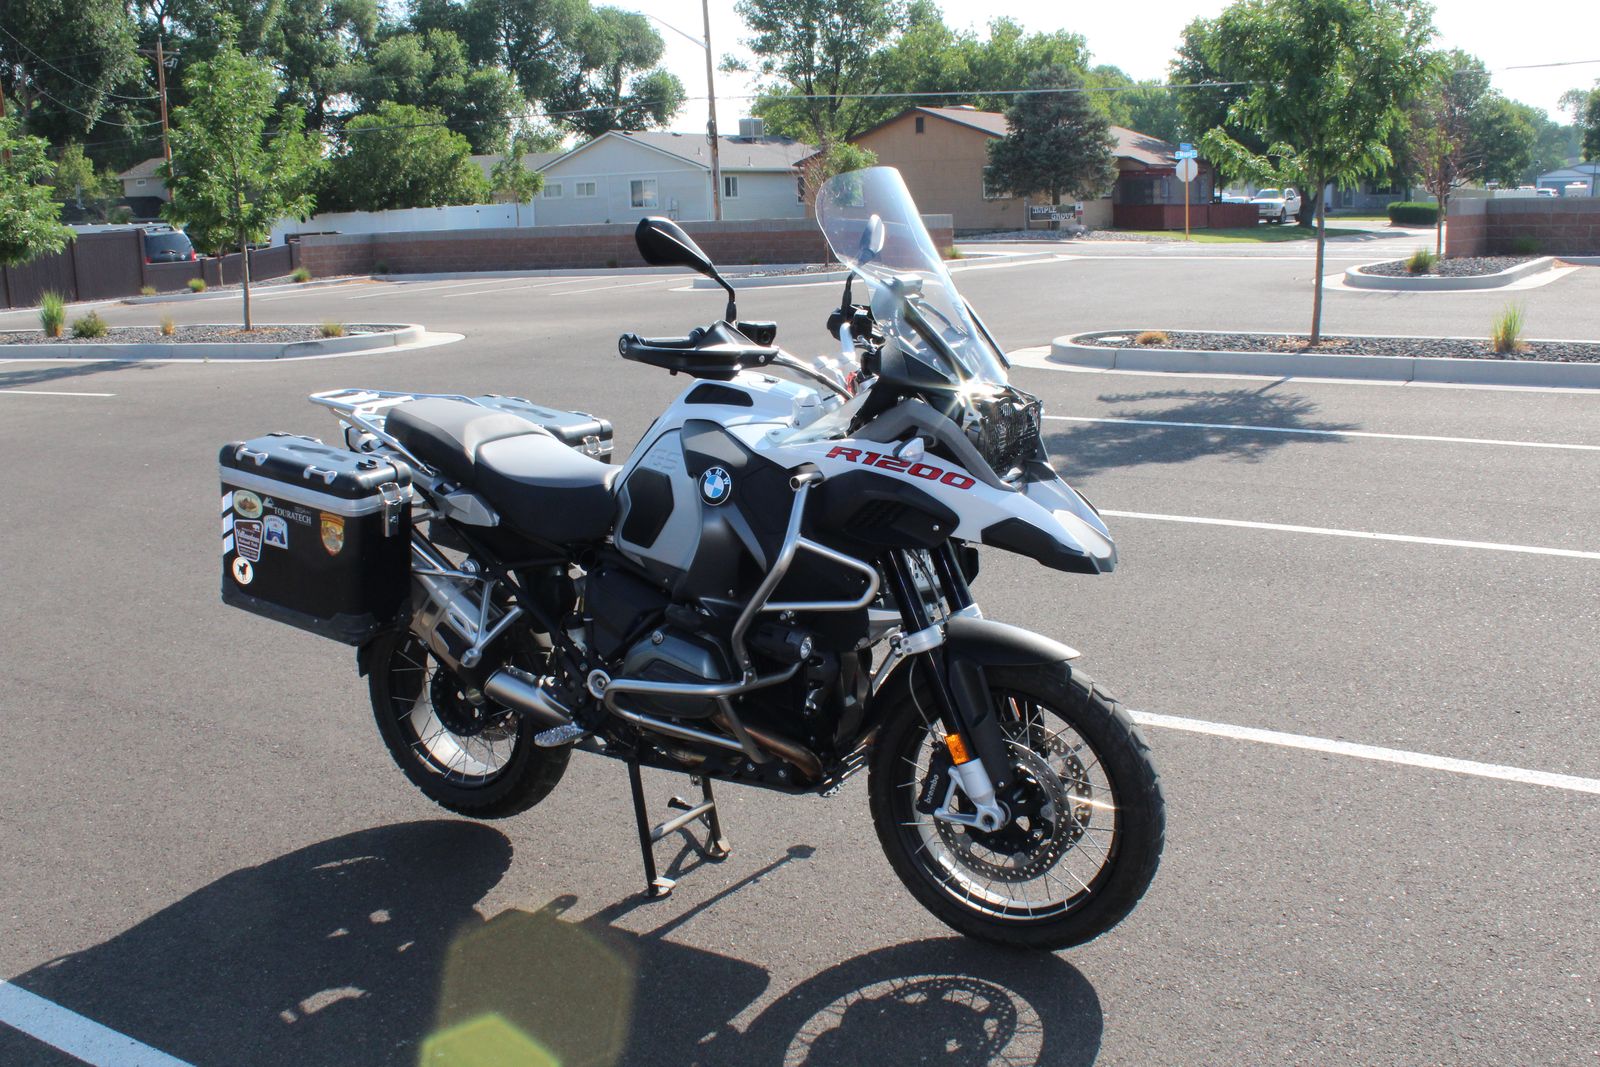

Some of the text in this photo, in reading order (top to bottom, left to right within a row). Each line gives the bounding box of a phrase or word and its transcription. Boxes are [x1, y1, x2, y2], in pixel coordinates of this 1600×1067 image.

[1032, 205, 1057, 214] MAPLE
[705, 468, 731, 485] BMW
[825, 445, 976, 490] R1200
[273, 506, 312, 525] TOURATECH
[923, 774, 940, 804] brembo
